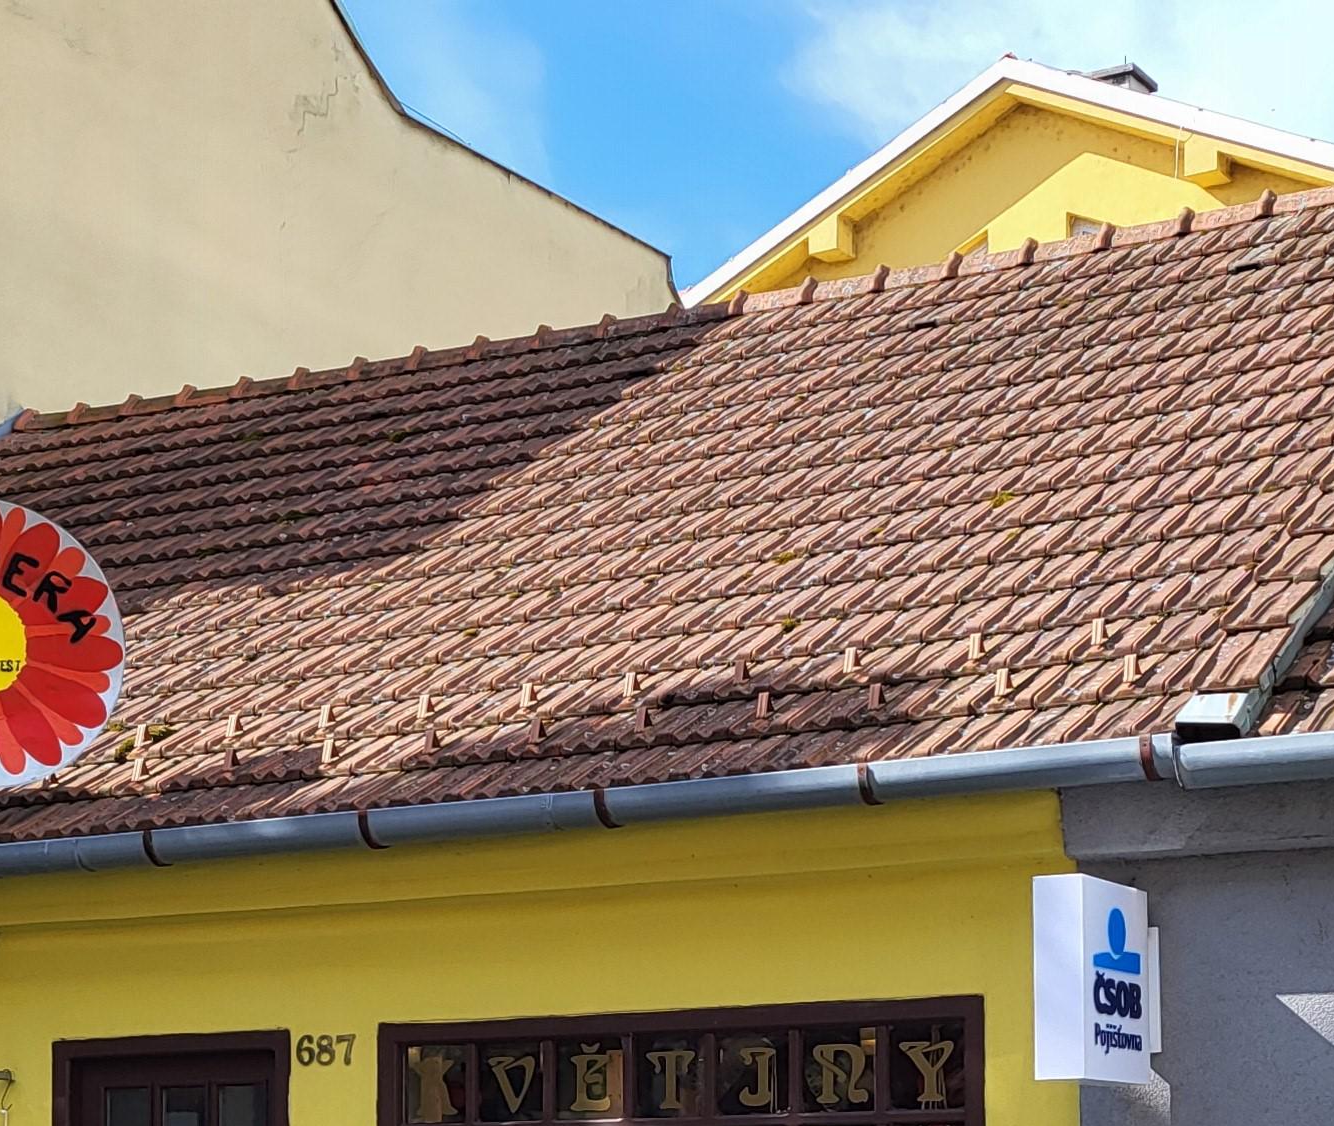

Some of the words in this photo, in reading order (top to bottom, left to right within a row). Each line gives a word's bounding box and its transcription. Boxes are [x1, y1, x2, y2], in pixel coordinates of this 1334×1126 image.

[1094, 971, 1142, 1019] ČSOB
[296, 1034, 356, 1066] 687
[1094, 1022, 1142, 1055] Pojišťovna
